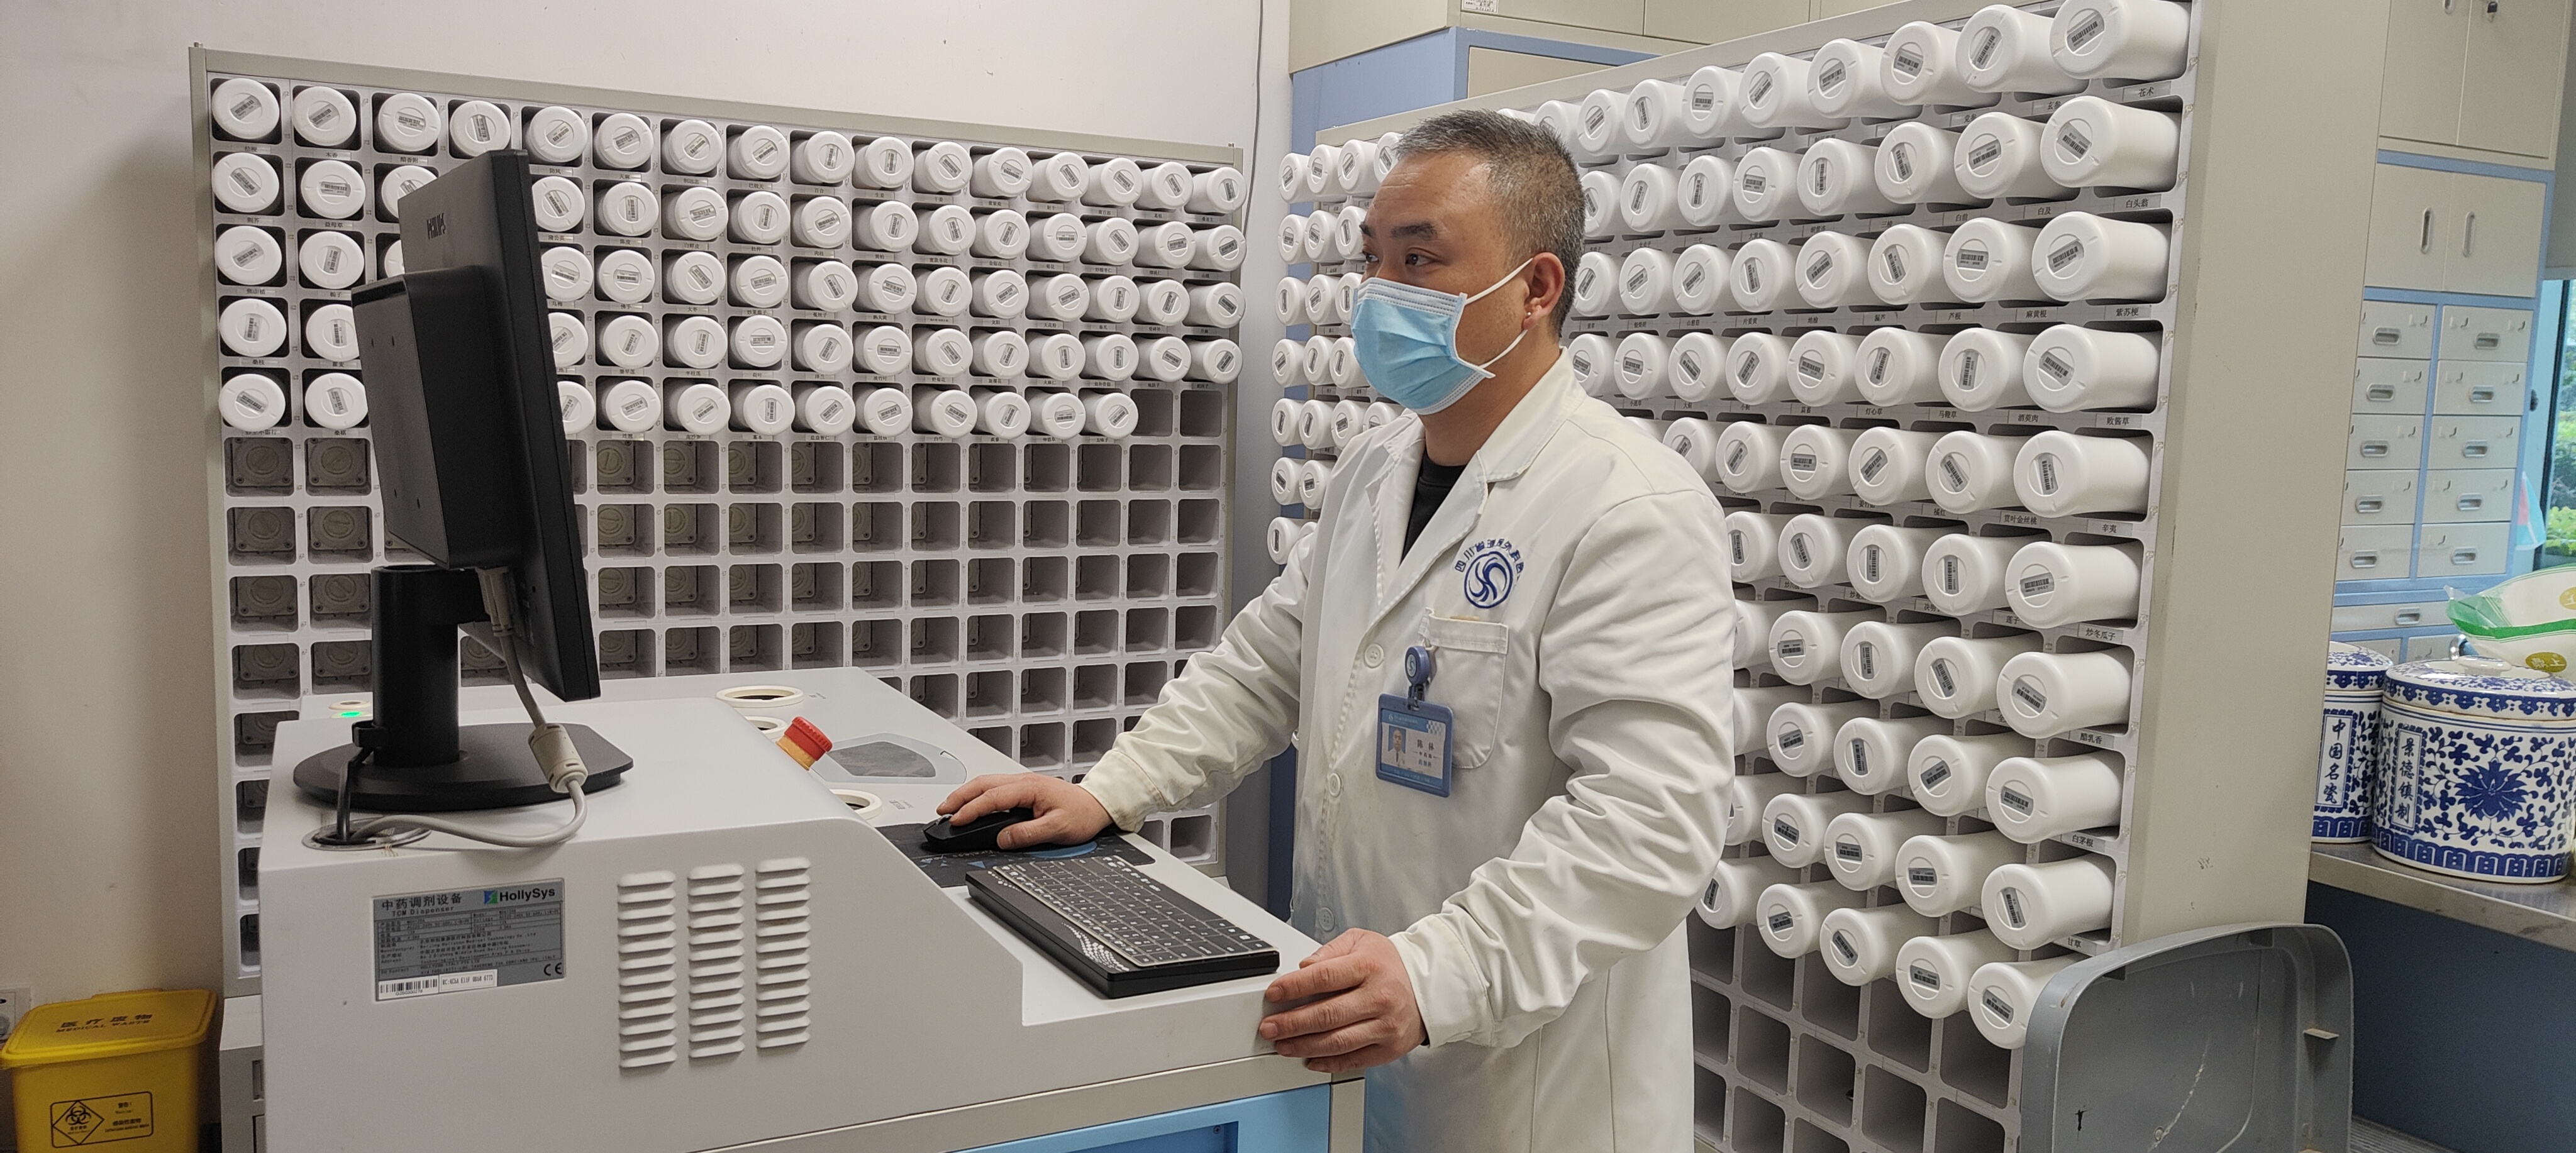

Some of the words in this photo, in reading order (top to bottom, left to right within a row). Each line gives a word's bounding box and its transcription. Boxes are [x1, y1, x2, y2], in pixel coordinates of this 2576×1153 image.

[2138, 87, 2153, 97] 苍术
[2126, 199, 2148, 208] 白头翁
[2038, 207, 2051, 215] 白及
[2026, 310, 2047, 318] 麻黄根
[2116, 307, 2139, 317] 紫苏梗
[2107, 417, 2129, 426] 败酱草
[2004, 514, 2037, 525] 贯叶金丝桃
[2102, 524, 2116, 533] 辛夷
[2085, 628, 2116, 641] 炒冬瓜子
[2080, 733, 2102, 744] 醋乳香
[2323, 718, 2344, 805] 中国名瓷
[2395, 737, 2416, 825] 景德镇制
[2072, 834, 2093, 847] 白茅根
[499, 888, 555, 902] HollySys
[382, 893, 462, 911] 中药调剂设备
[410, 906, 454, 916] Dispenser
[2068, 937, 2081, 948] 甘草
[61, 1014, 153, 1028] 医疗废物
[56, 1023, 106, 1033] MEDICAL
